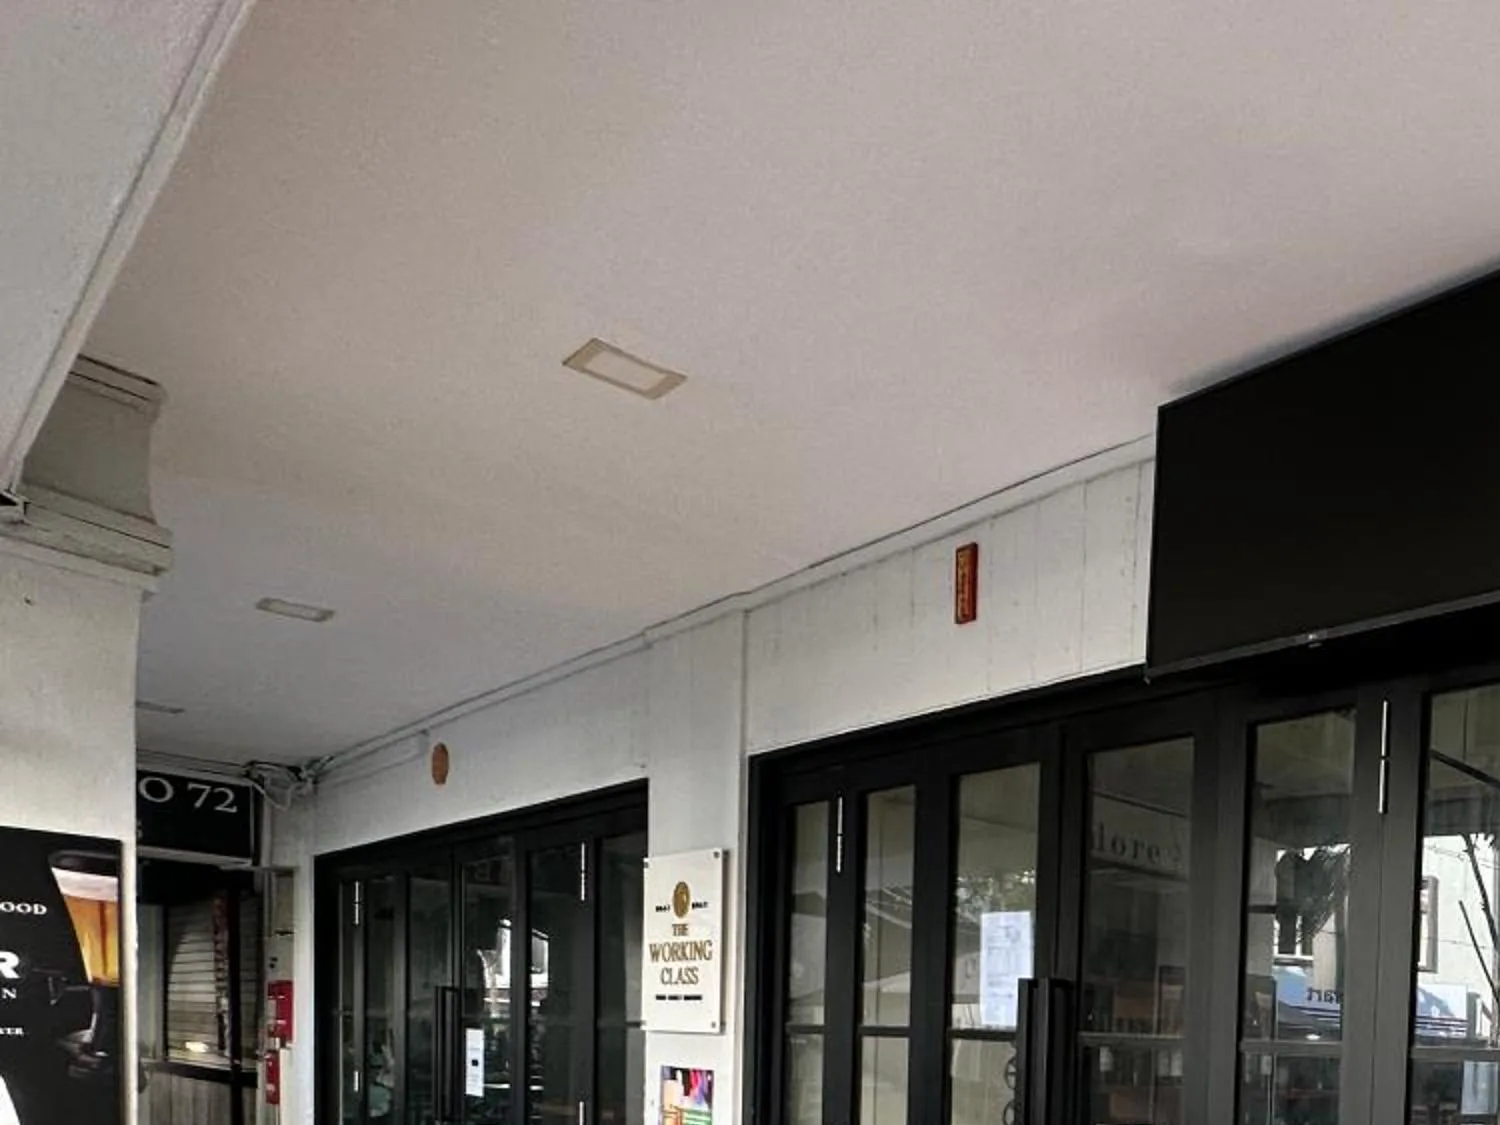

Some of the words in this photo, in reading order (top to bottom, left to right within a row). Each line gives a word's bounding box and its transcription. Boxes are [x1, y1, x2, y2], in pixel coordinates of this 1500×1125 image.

[187, 782, 238, 813] 72
[672, 923, 688, 937] THE
[649, 939, 714, 963] WORKING
[660, 966, 700, 986] CLASS
